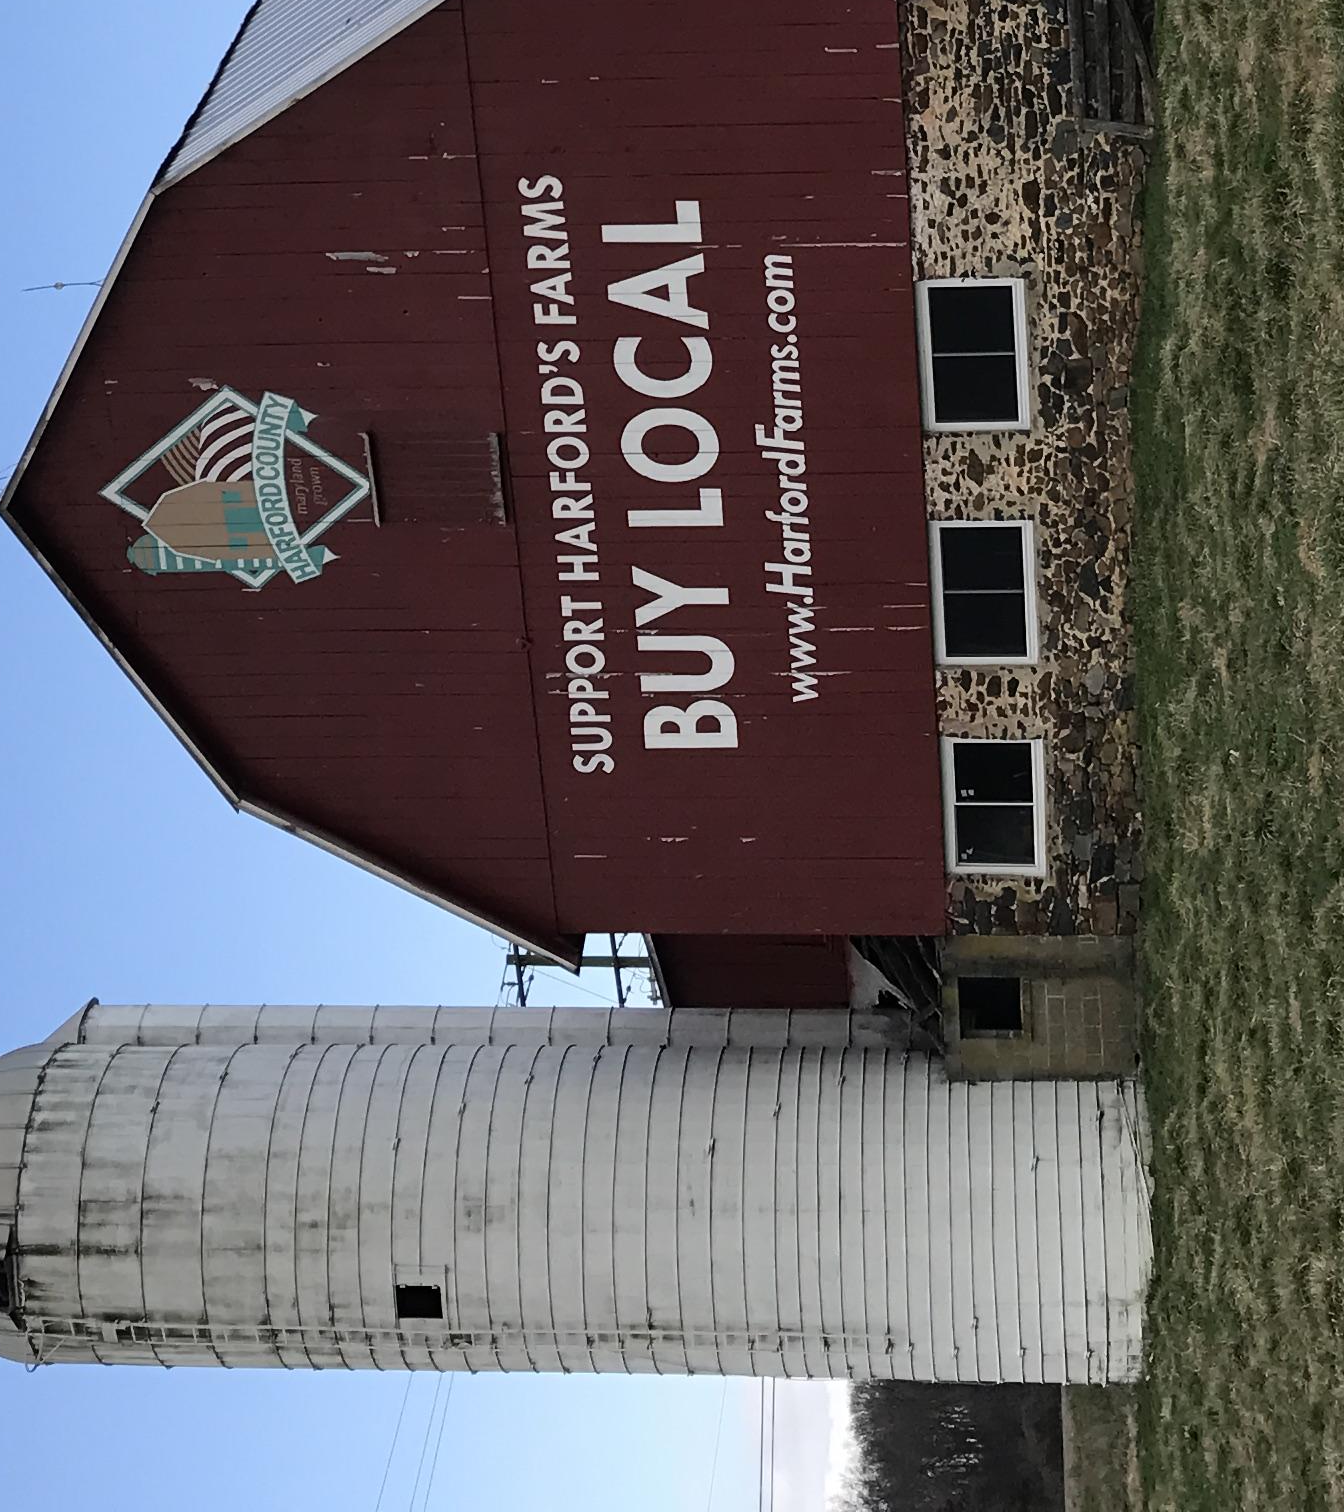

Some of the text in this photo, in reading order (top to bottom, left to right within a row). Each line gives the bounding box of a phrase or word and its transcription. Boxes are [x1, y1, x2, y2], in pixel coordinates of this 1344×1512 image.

[256, 395, 316, 580] HARFORD COUNTY
[288, 457, 308, 515] maryland
[309, 467, 327, 505] grown
[517, 175, 615, 774] SUPPORT HARFORD'S FARMS
[601, 200, 739, 750] BUY LOCAL
[754, 254, 819, 703] www.HarfordFarms.com
